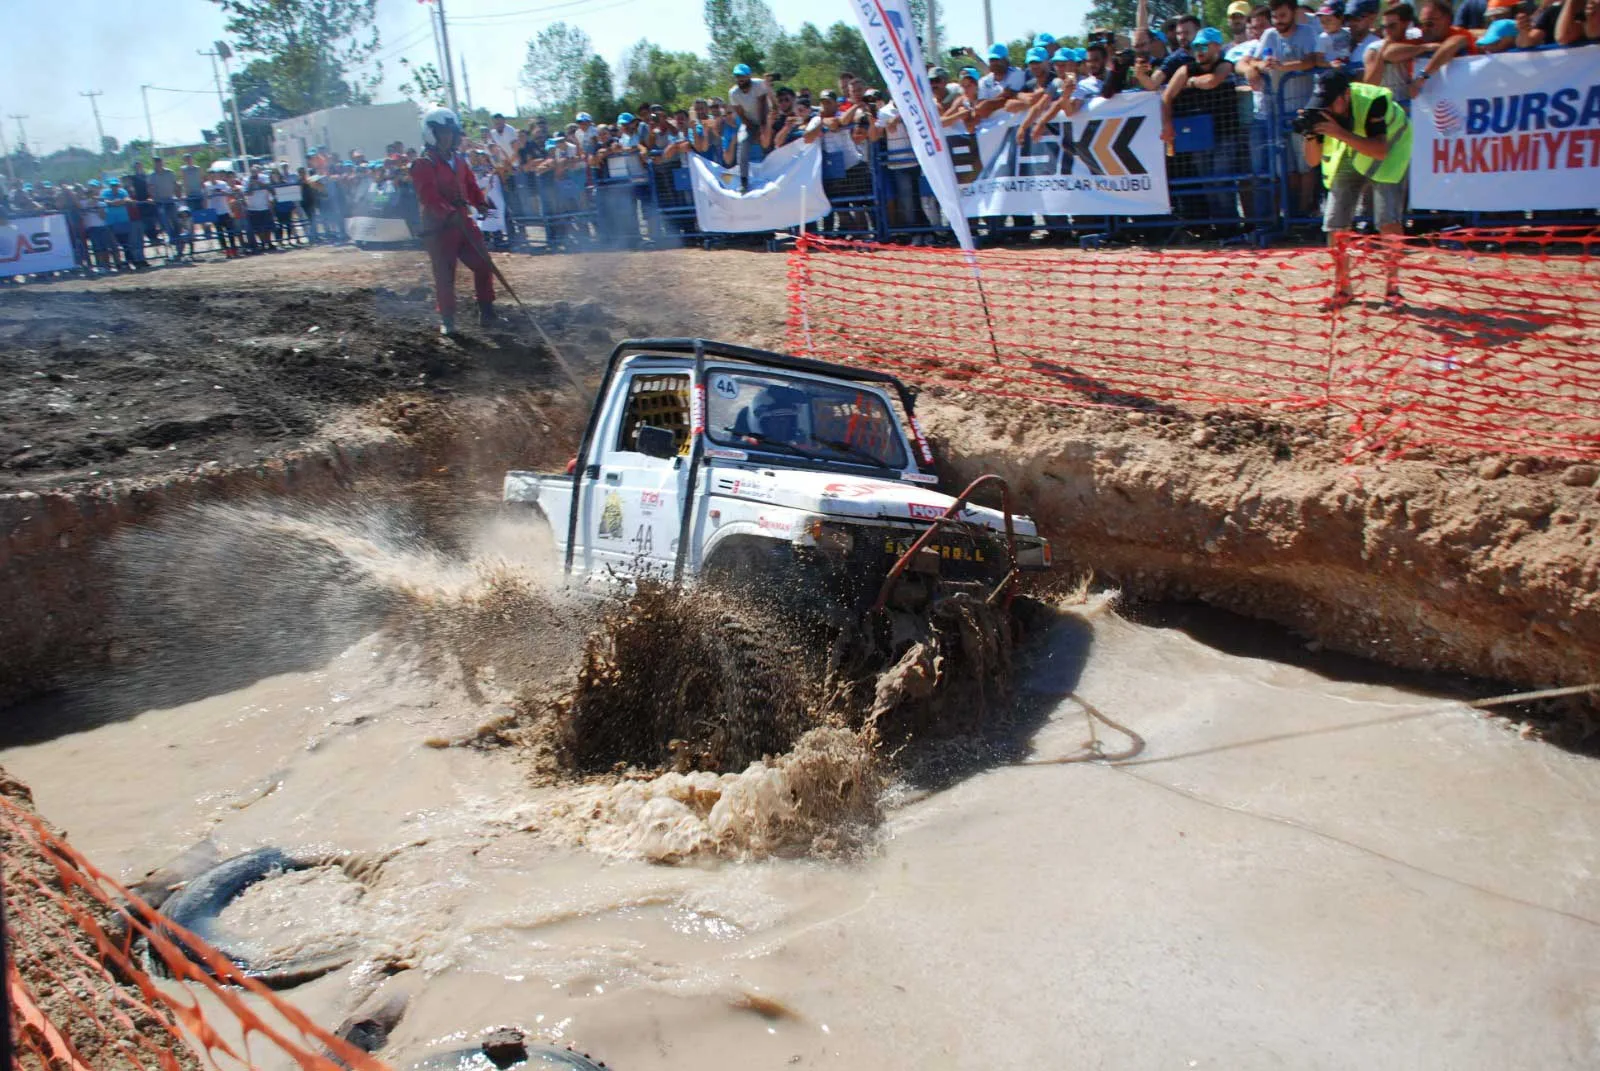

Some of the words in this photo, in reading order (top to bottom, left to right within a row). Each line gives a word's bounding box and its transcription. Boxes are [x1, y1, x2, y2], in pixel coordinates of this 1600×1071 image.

[1466, 85, 1600, 135] BURSA
[1432, 128, 1600, 173] HAKİMİYET
[1095, 176, 1152, 193] KULÜBÜ
[717, 379, 736, 396] 4A
[636, 523, 653, 552] 4A
